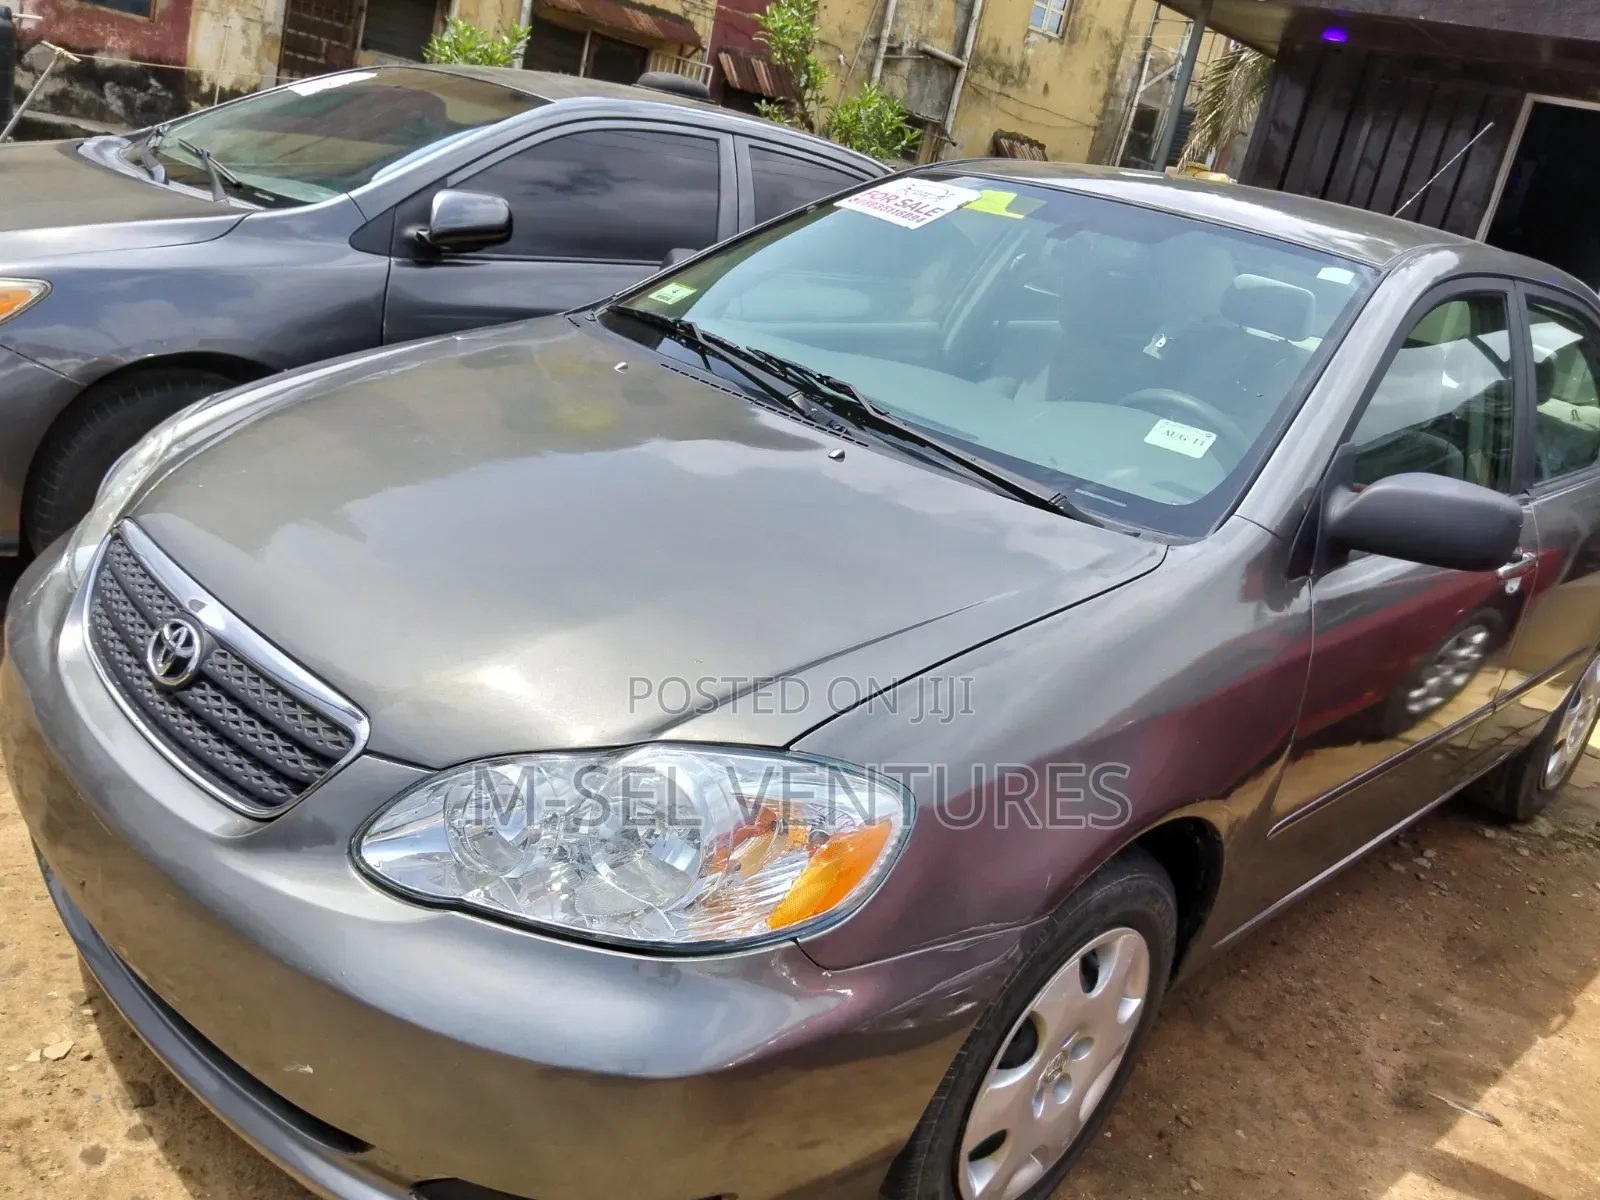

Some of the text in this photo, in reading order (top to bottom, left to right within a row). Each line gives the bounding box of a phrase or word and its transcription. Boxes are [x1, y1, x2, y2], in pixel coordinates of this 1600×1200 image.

[860, 190, 946, 217] FOR SALE
[1163, 429, 1189, 442] AUG
